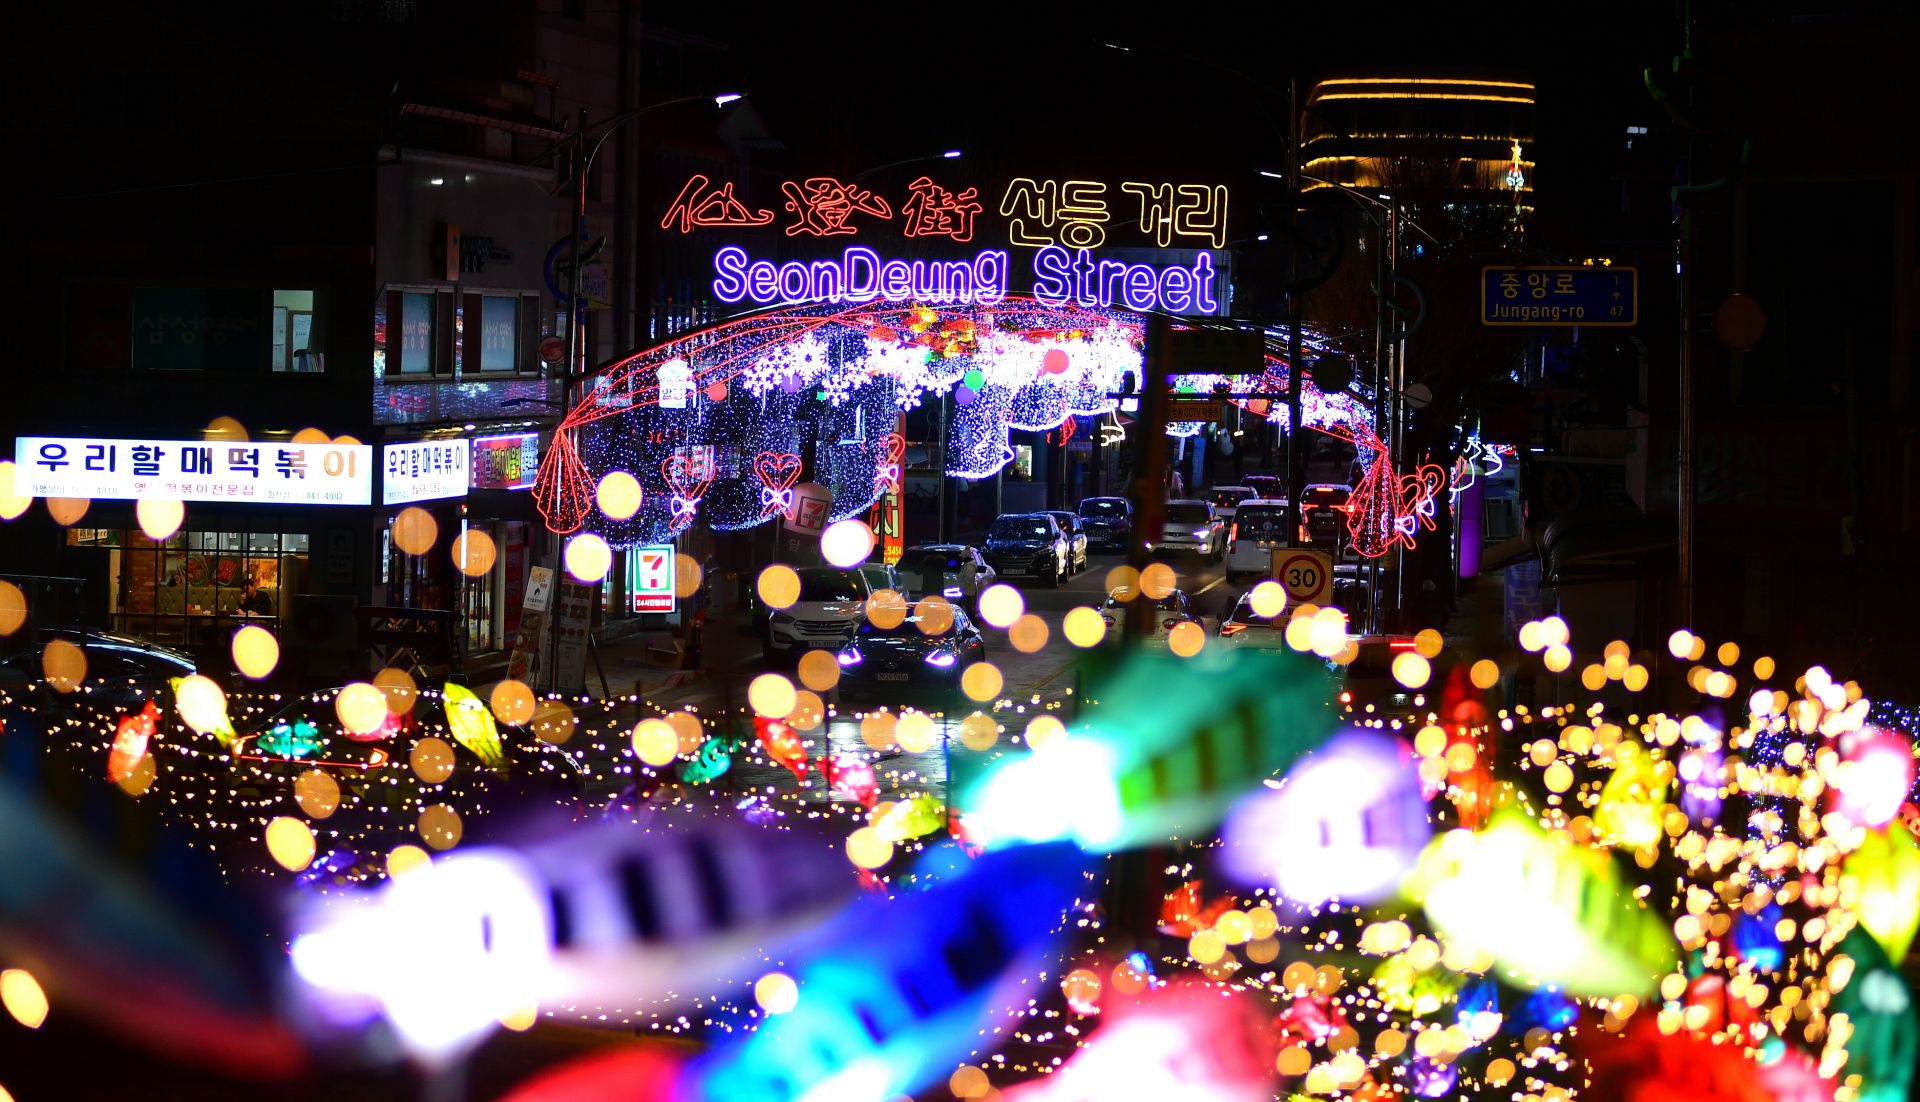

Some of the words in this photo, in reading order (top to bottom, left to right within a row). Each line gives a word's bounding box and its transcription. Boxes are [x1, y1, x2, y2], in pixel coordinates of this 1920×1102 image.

[713, 246, 1008, 306] SeonDeung
[1033, 245, 1218, 313] Street
[1499, 273, 1576, 299] 중앙로
[1491, 303, 1585, 321] Jungang-ro
[1609, 306, 1624, 317] 47
[36, 443, 355, 480] 우리할매떡볶이
[388, 445, 463, 478] 우리할매떡볶이
[643, 555, 663, 588] 7
[1288, 568, 1316, 588] 30
